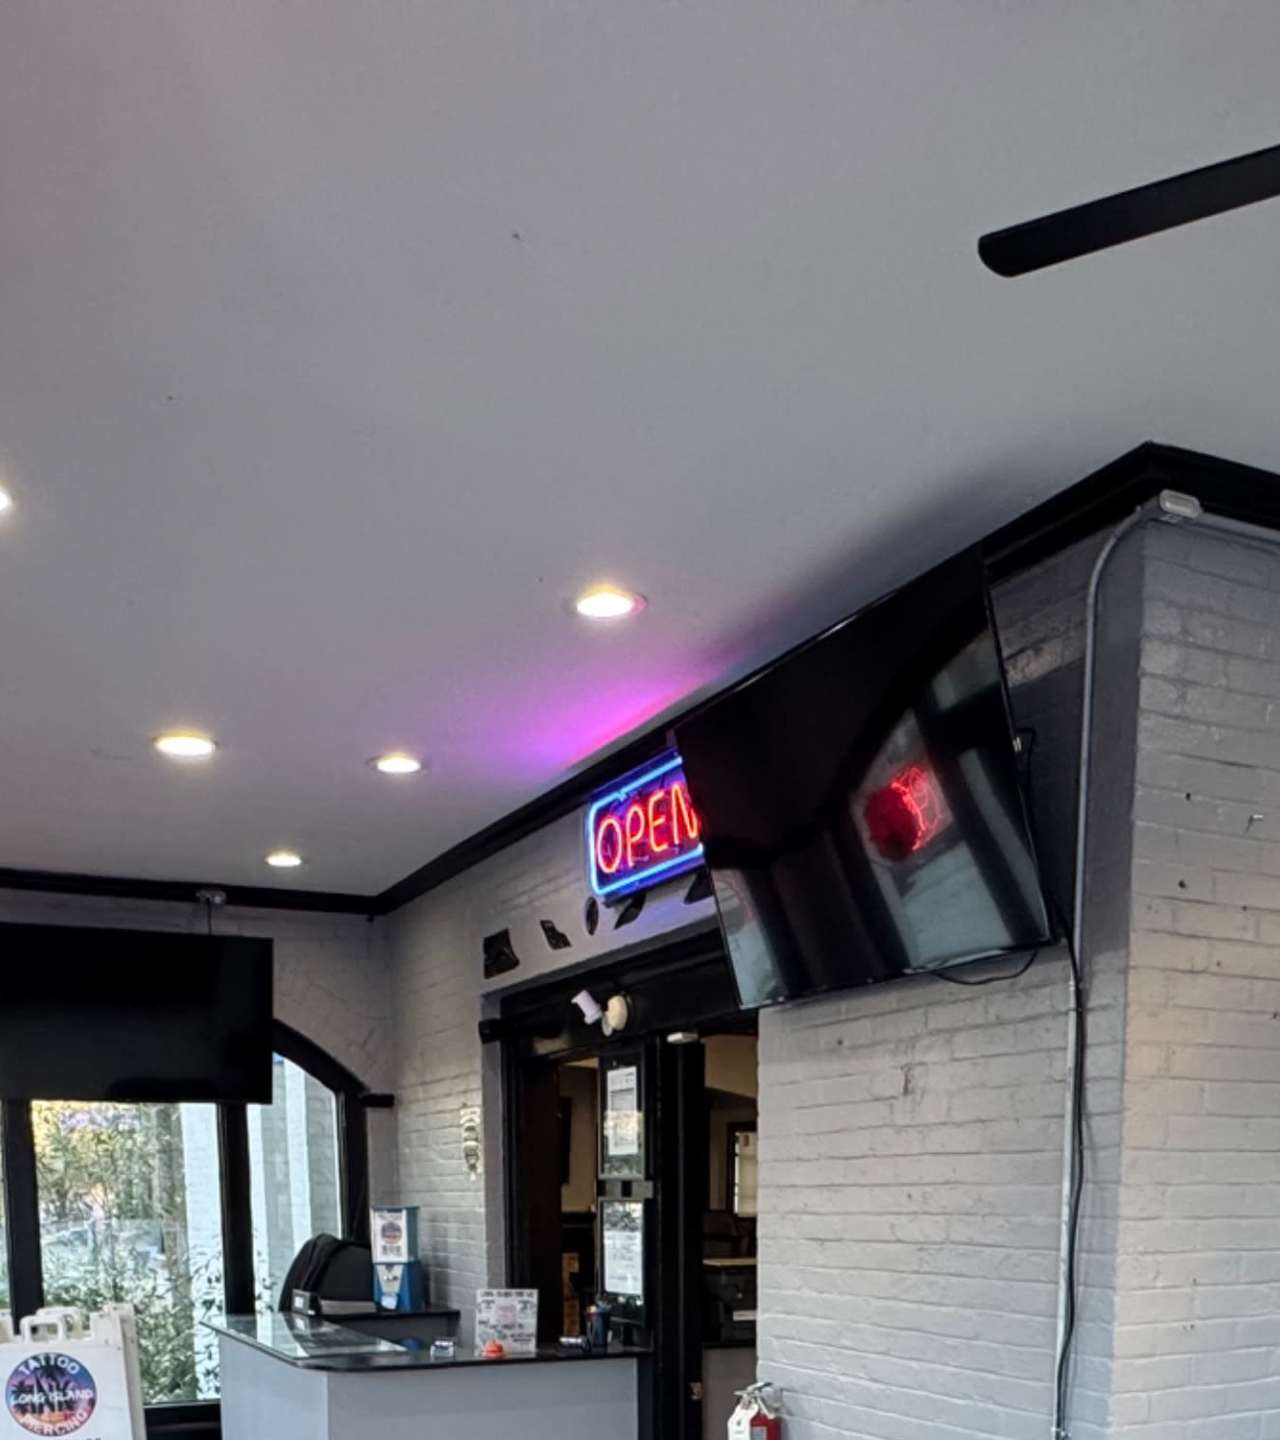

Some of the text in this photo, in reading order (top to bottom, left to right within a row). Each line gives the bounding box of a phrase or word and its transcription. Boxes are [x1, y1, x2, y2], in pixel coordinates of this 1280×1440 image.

[597, 783, 699, 874] OPEN
[18, 1353, 80, 1375] TATTOO
[10, 1388, 93, 1405] LONG ISLAND
[19, 1409, 89, 1435] PIERCING
